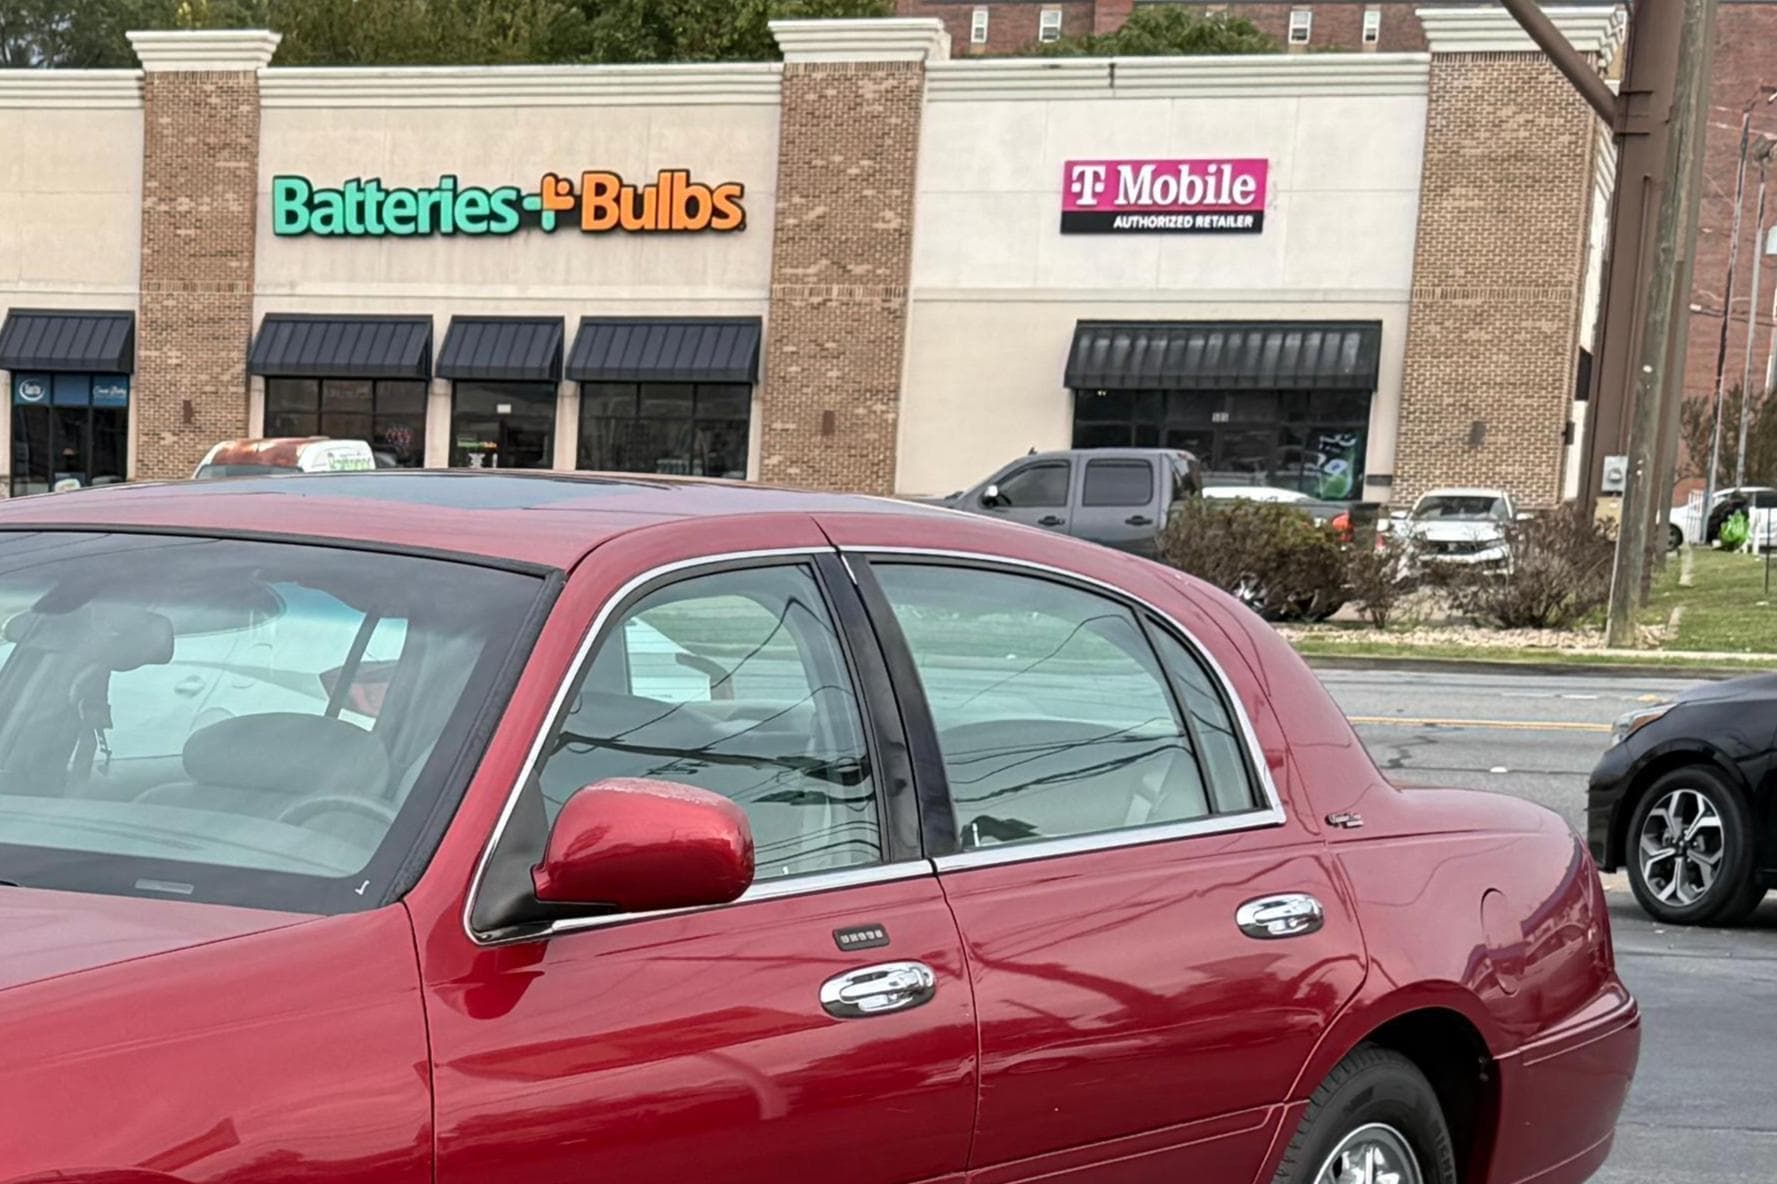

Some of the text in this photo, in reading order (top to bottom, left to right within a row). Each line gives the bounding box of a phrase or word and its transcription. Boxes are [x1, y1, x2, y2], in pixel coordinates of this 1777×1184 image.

[272, 174, 521, 236] Batteries
[580, 168, 745, 233] Bulbs
[1114, 163, 1257, 206] Mobile
[1112, 214, 1255, 229] AUTHORIZED RETAILER
